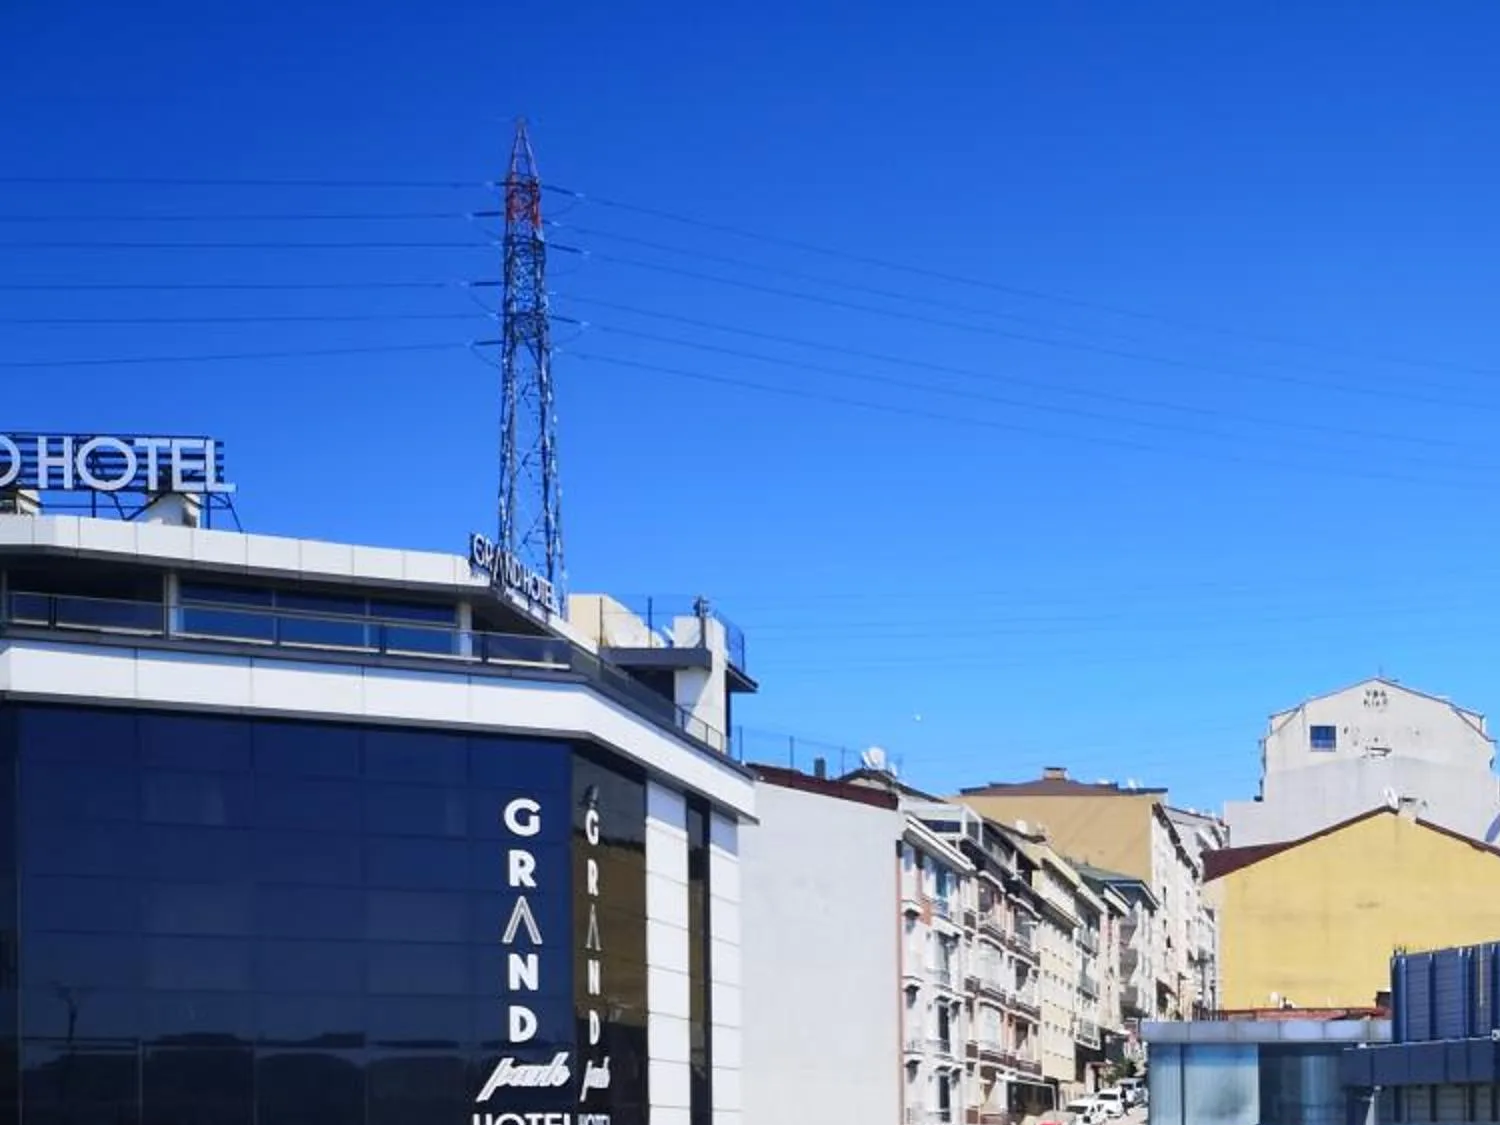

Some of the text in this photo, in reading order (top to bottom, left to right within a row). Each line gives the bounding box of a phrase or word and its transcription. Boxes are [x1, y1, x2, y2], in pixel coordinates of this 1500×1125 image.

[37, 435, 237, 493] HOTEL
[501, 797, 543, 1043] GRAND
[584, 808, 602, 1046] GRAND
